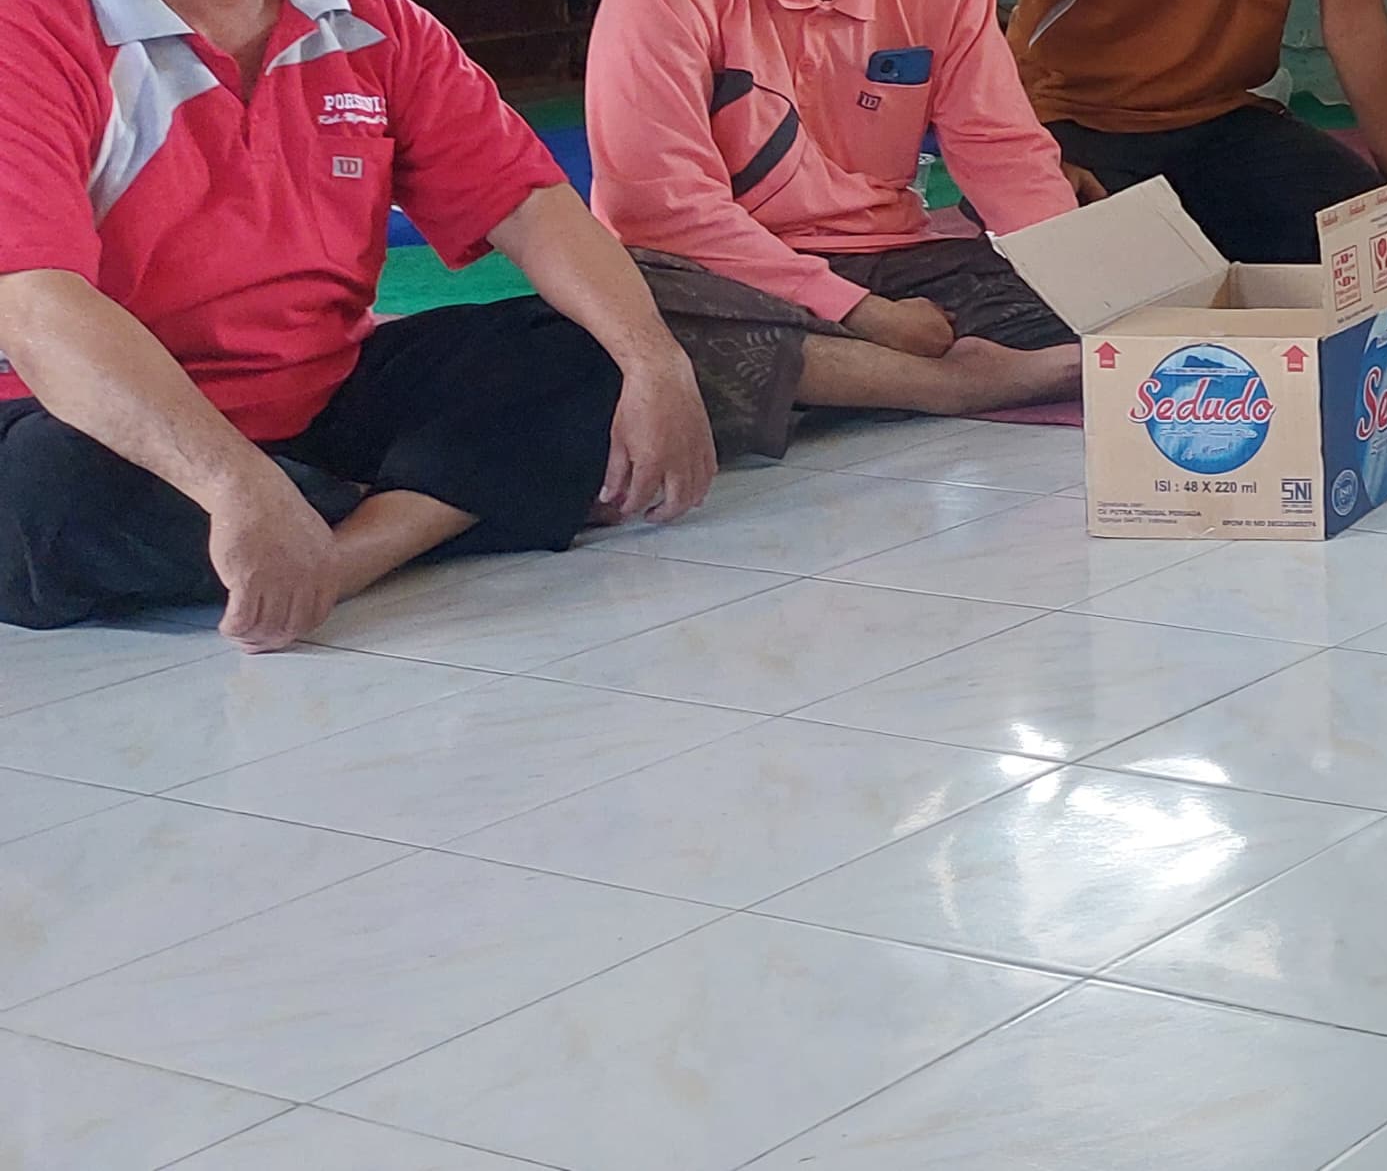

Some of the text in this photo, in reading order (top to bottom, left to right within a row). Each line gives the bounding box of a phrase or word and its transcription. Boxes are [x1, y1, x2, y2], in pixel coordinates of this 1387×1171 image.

[1128, 376, 1276, 423] Sedudo
[1155, 480, 1171, 492] ISI
[1183, 481, 1198, 492] 48
[1202, 481, 1212, 493] X
[1215, 481, 1237, 493] 220
[1241, 482, 1257, 494] ml
[1281, 482, 1312, 500] SNI
